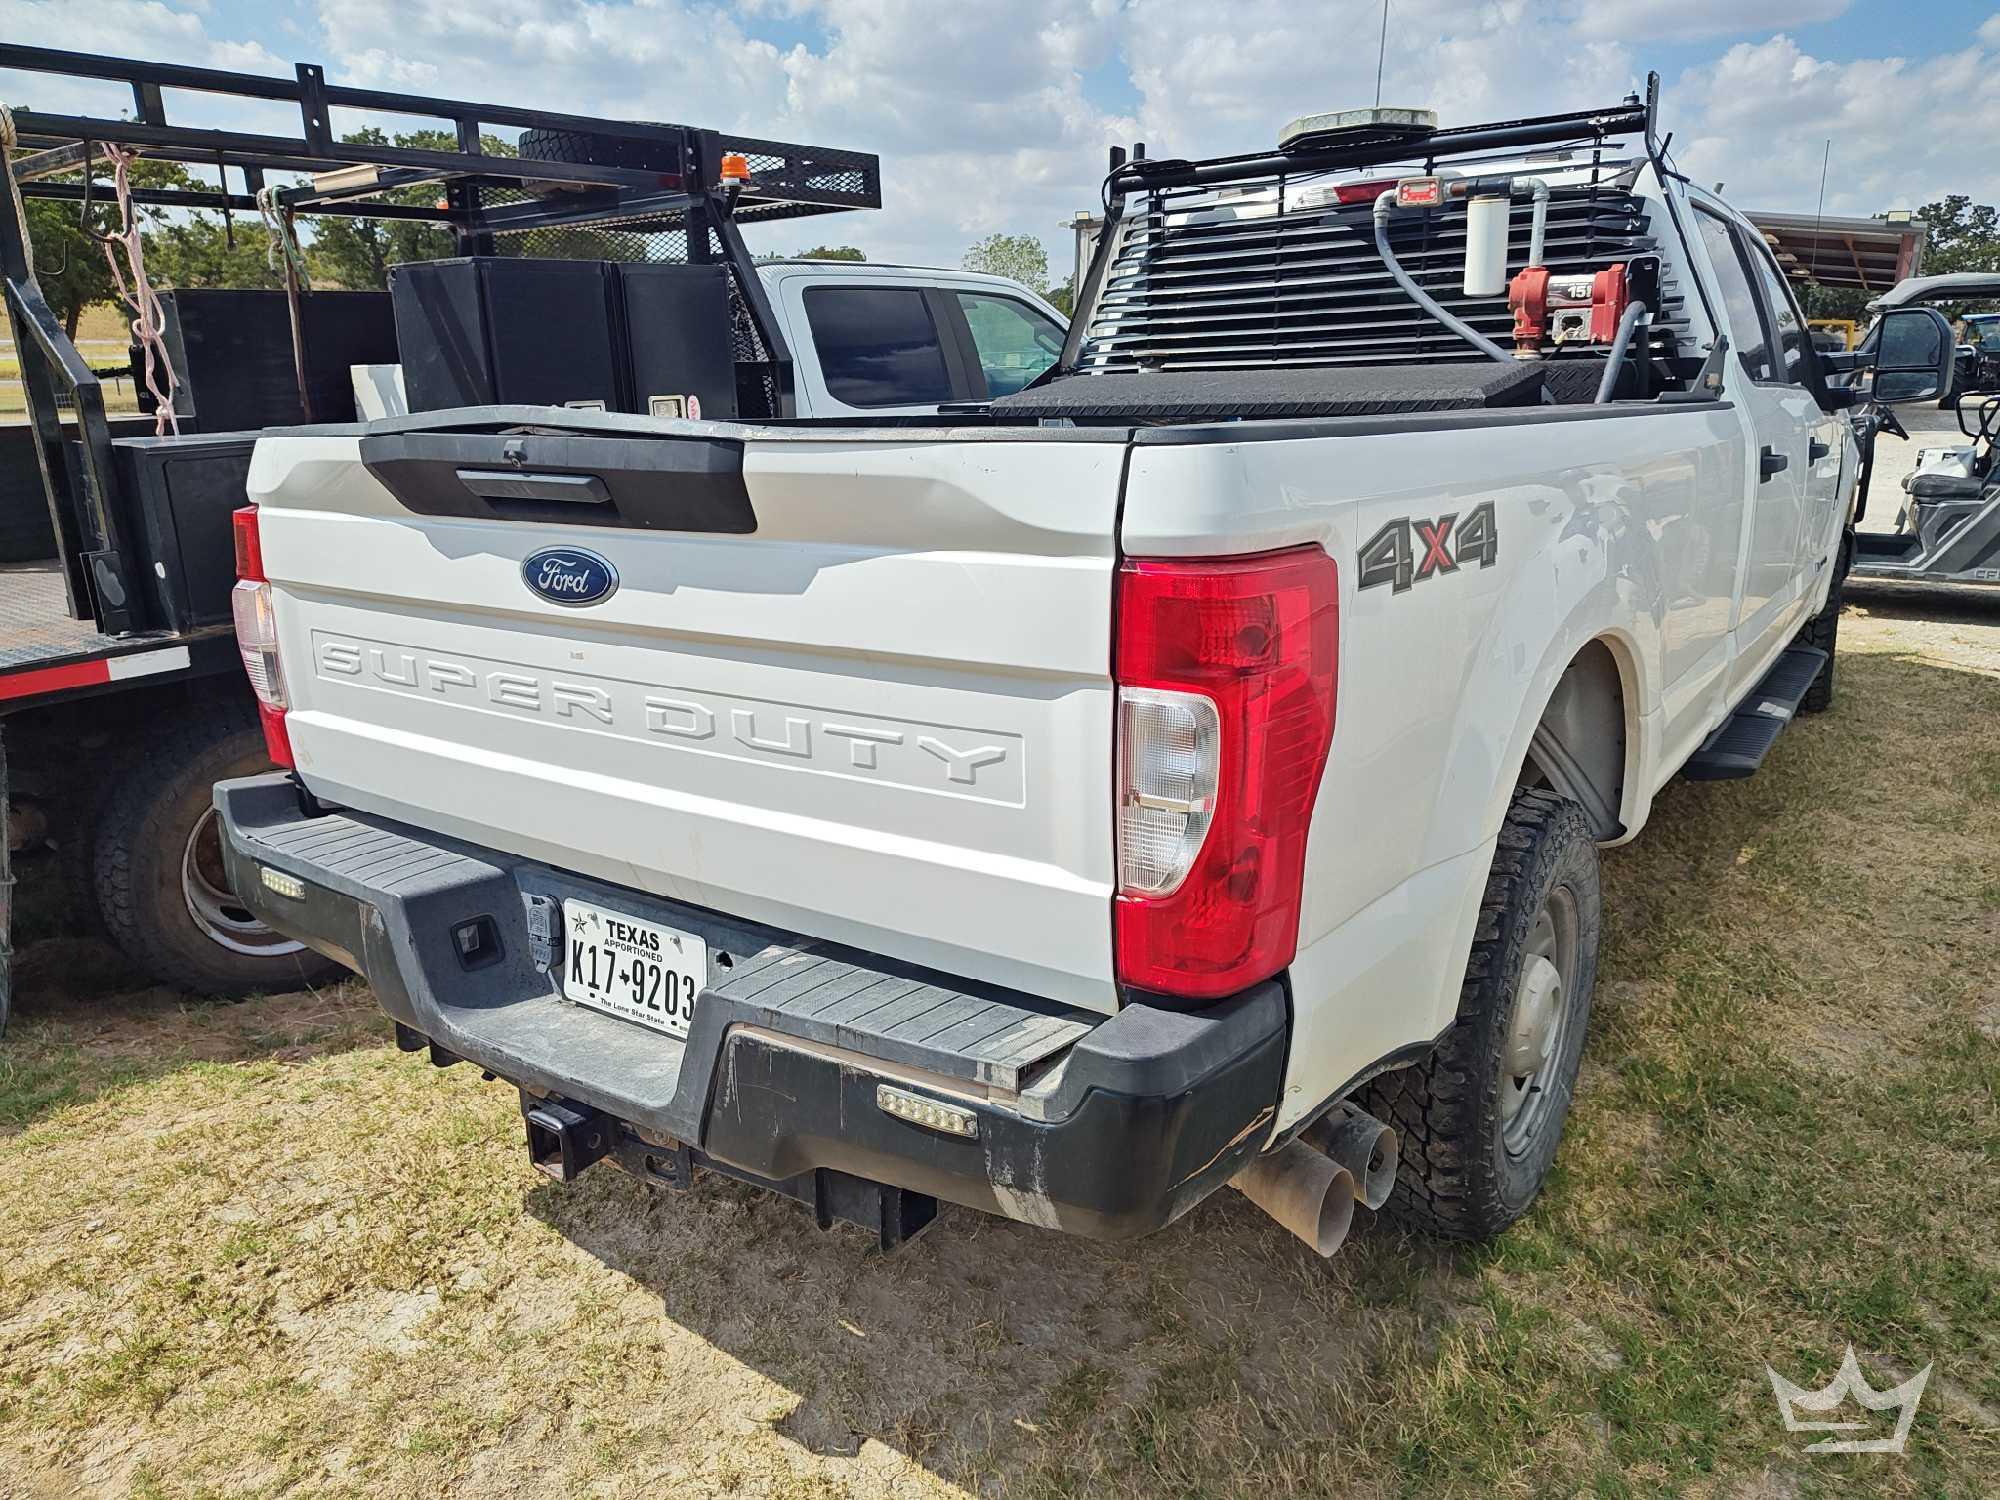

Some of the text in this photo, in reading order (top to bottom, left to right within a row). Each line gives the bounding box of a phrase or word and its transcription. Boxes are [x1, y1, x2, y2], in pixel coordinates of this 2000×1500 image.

[1357, 500, 1498, 596] 4X4
[538, 558, 590, 593] Ford
[320, 642, 1006, 786] SUPER DUTY
[604, 938, 663, 963] APPORTIONED
[606, 919, 660, 951] TEXAS
[572, 939, 695, 1021] K17 9203
[600, 997, 665, 1025] The Lone Star State
